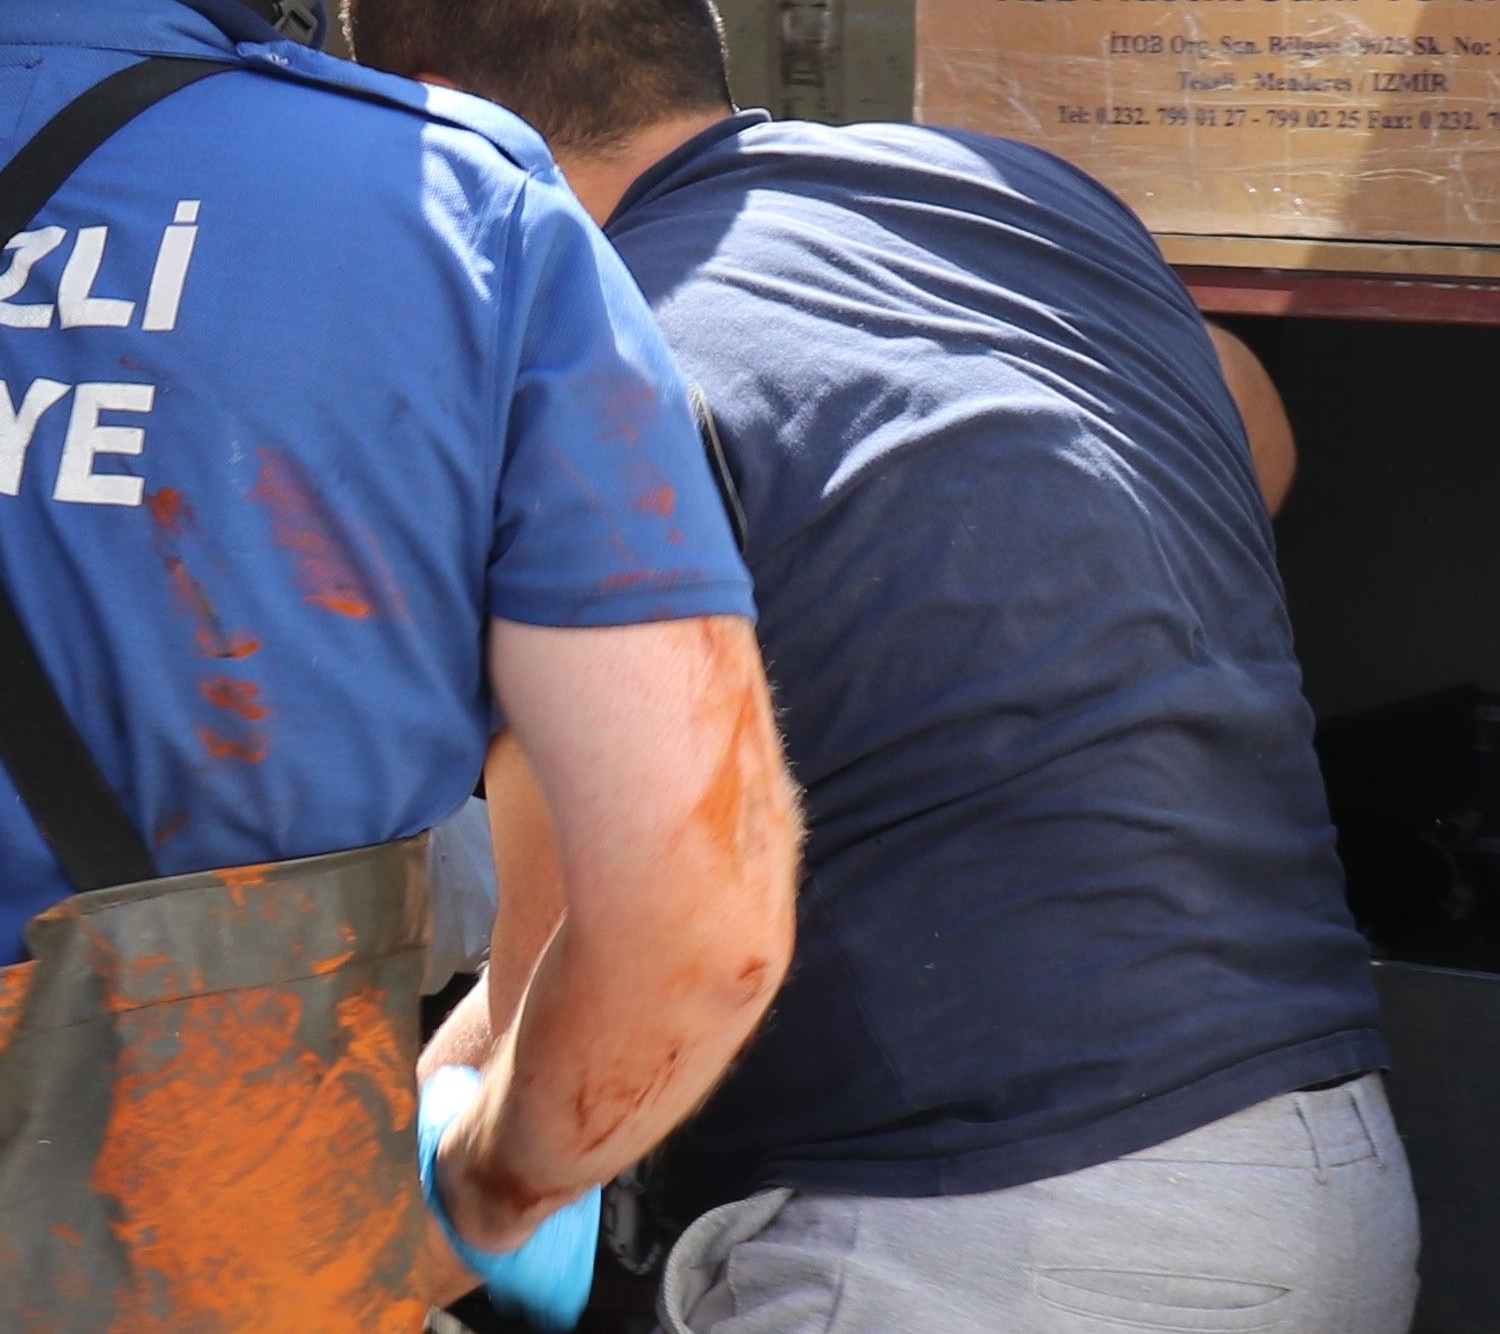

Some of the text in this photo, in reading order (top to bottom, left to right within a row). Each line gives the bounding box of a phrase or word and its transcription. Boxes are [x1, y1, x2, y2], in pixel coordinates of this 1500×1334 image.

[1454, 36, 1490, 55] No:
[1224, 109, 1246, 127] 27
[1265, 109, 1300, 128] 799
